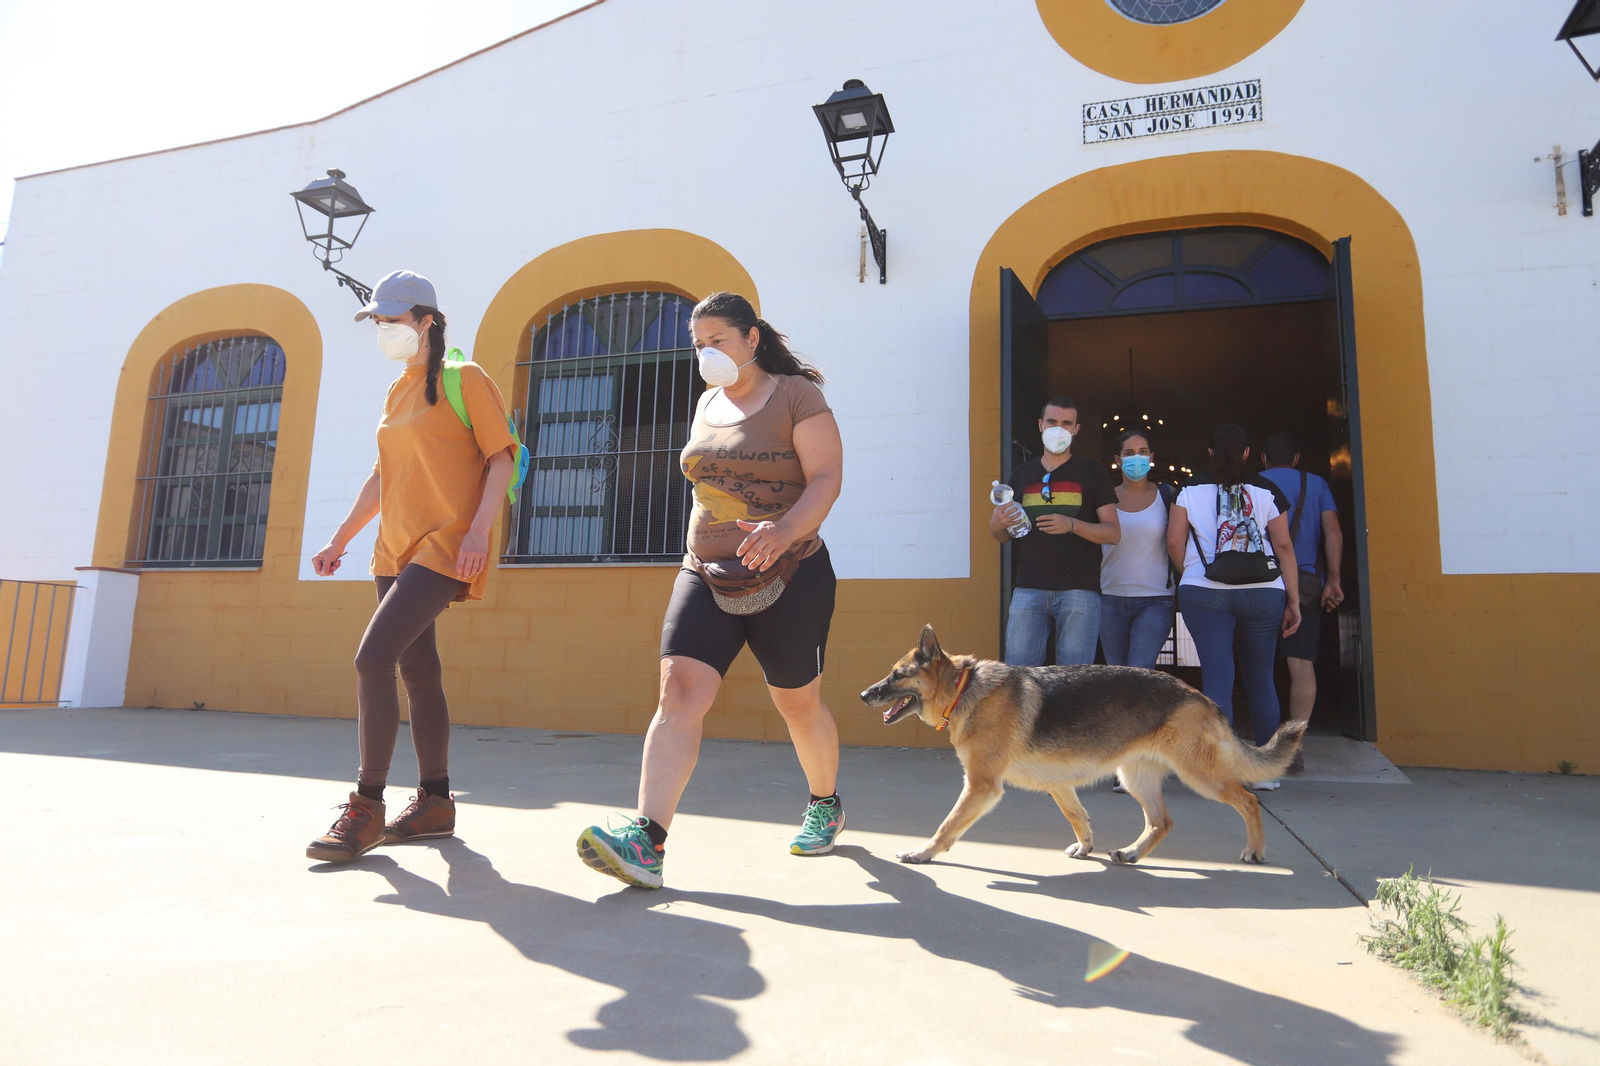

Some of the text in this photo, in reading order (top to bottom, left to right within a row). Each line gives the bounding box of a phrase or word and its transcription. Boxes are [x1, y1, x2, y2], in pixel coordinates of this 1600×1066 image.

[1086, 83, 1258, 120] CASA HERMANDAD
[1099, 104, 1259, 140] SAN JOSE 1994
